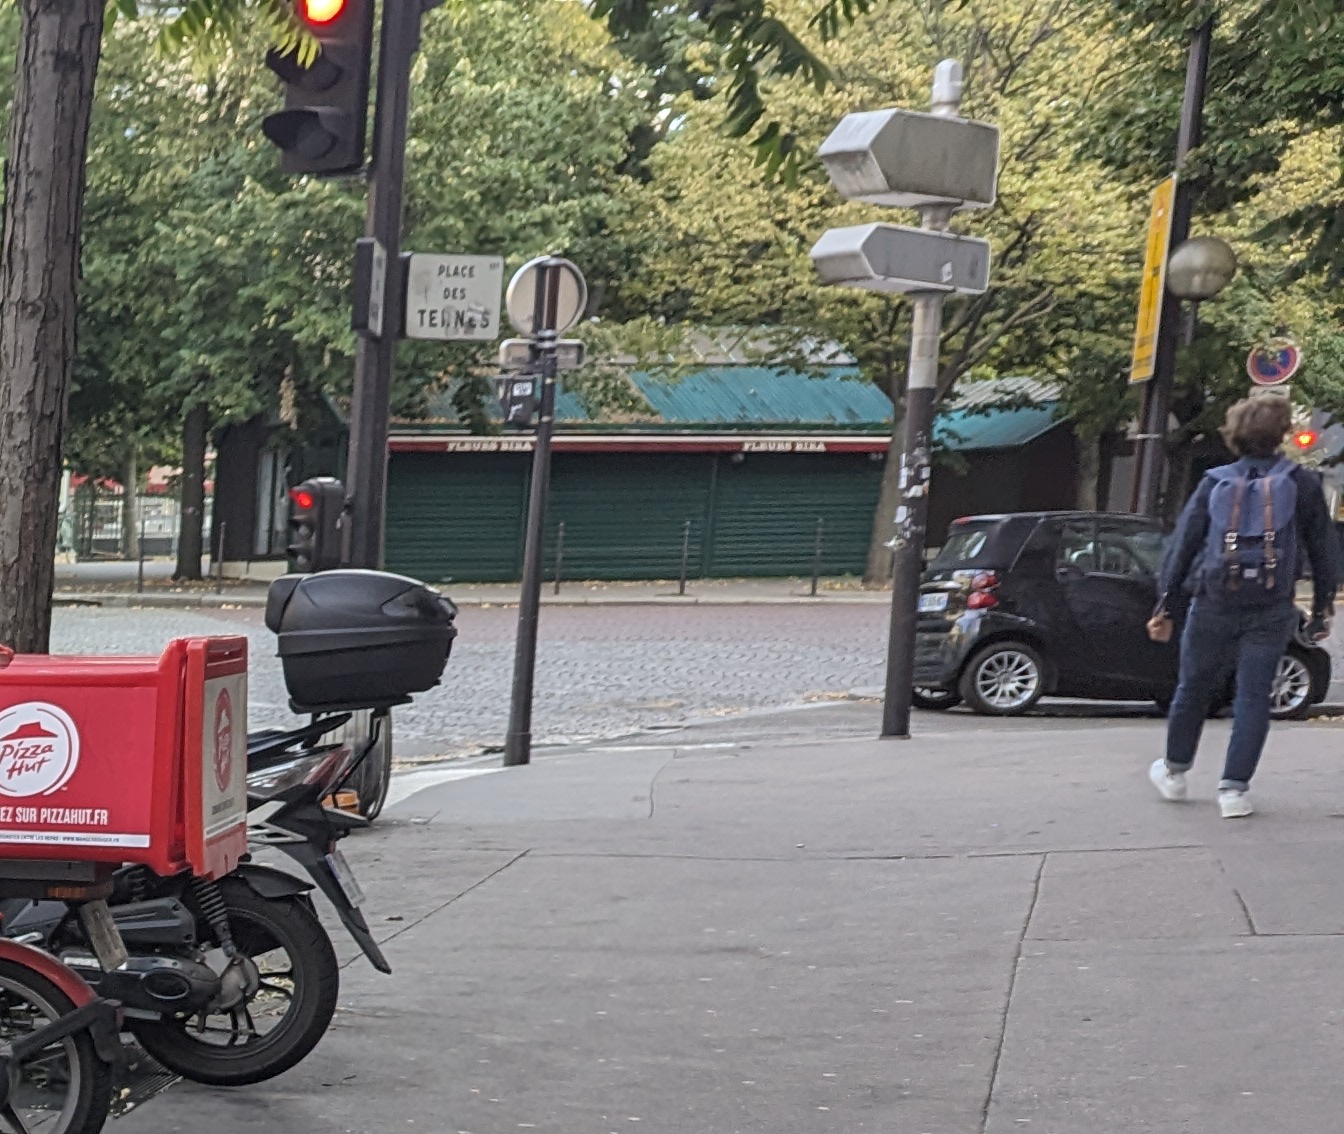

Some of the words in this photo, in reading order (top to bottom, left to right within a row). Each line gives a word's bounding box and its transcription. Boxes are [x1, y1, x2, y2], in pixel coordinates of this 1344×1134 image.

[438, 264, 475, 278] PLACE
[443, 287, 466, 299] DES
[6, 757, 51, 780] Hut
[16, 807, 37, 823] SUR
